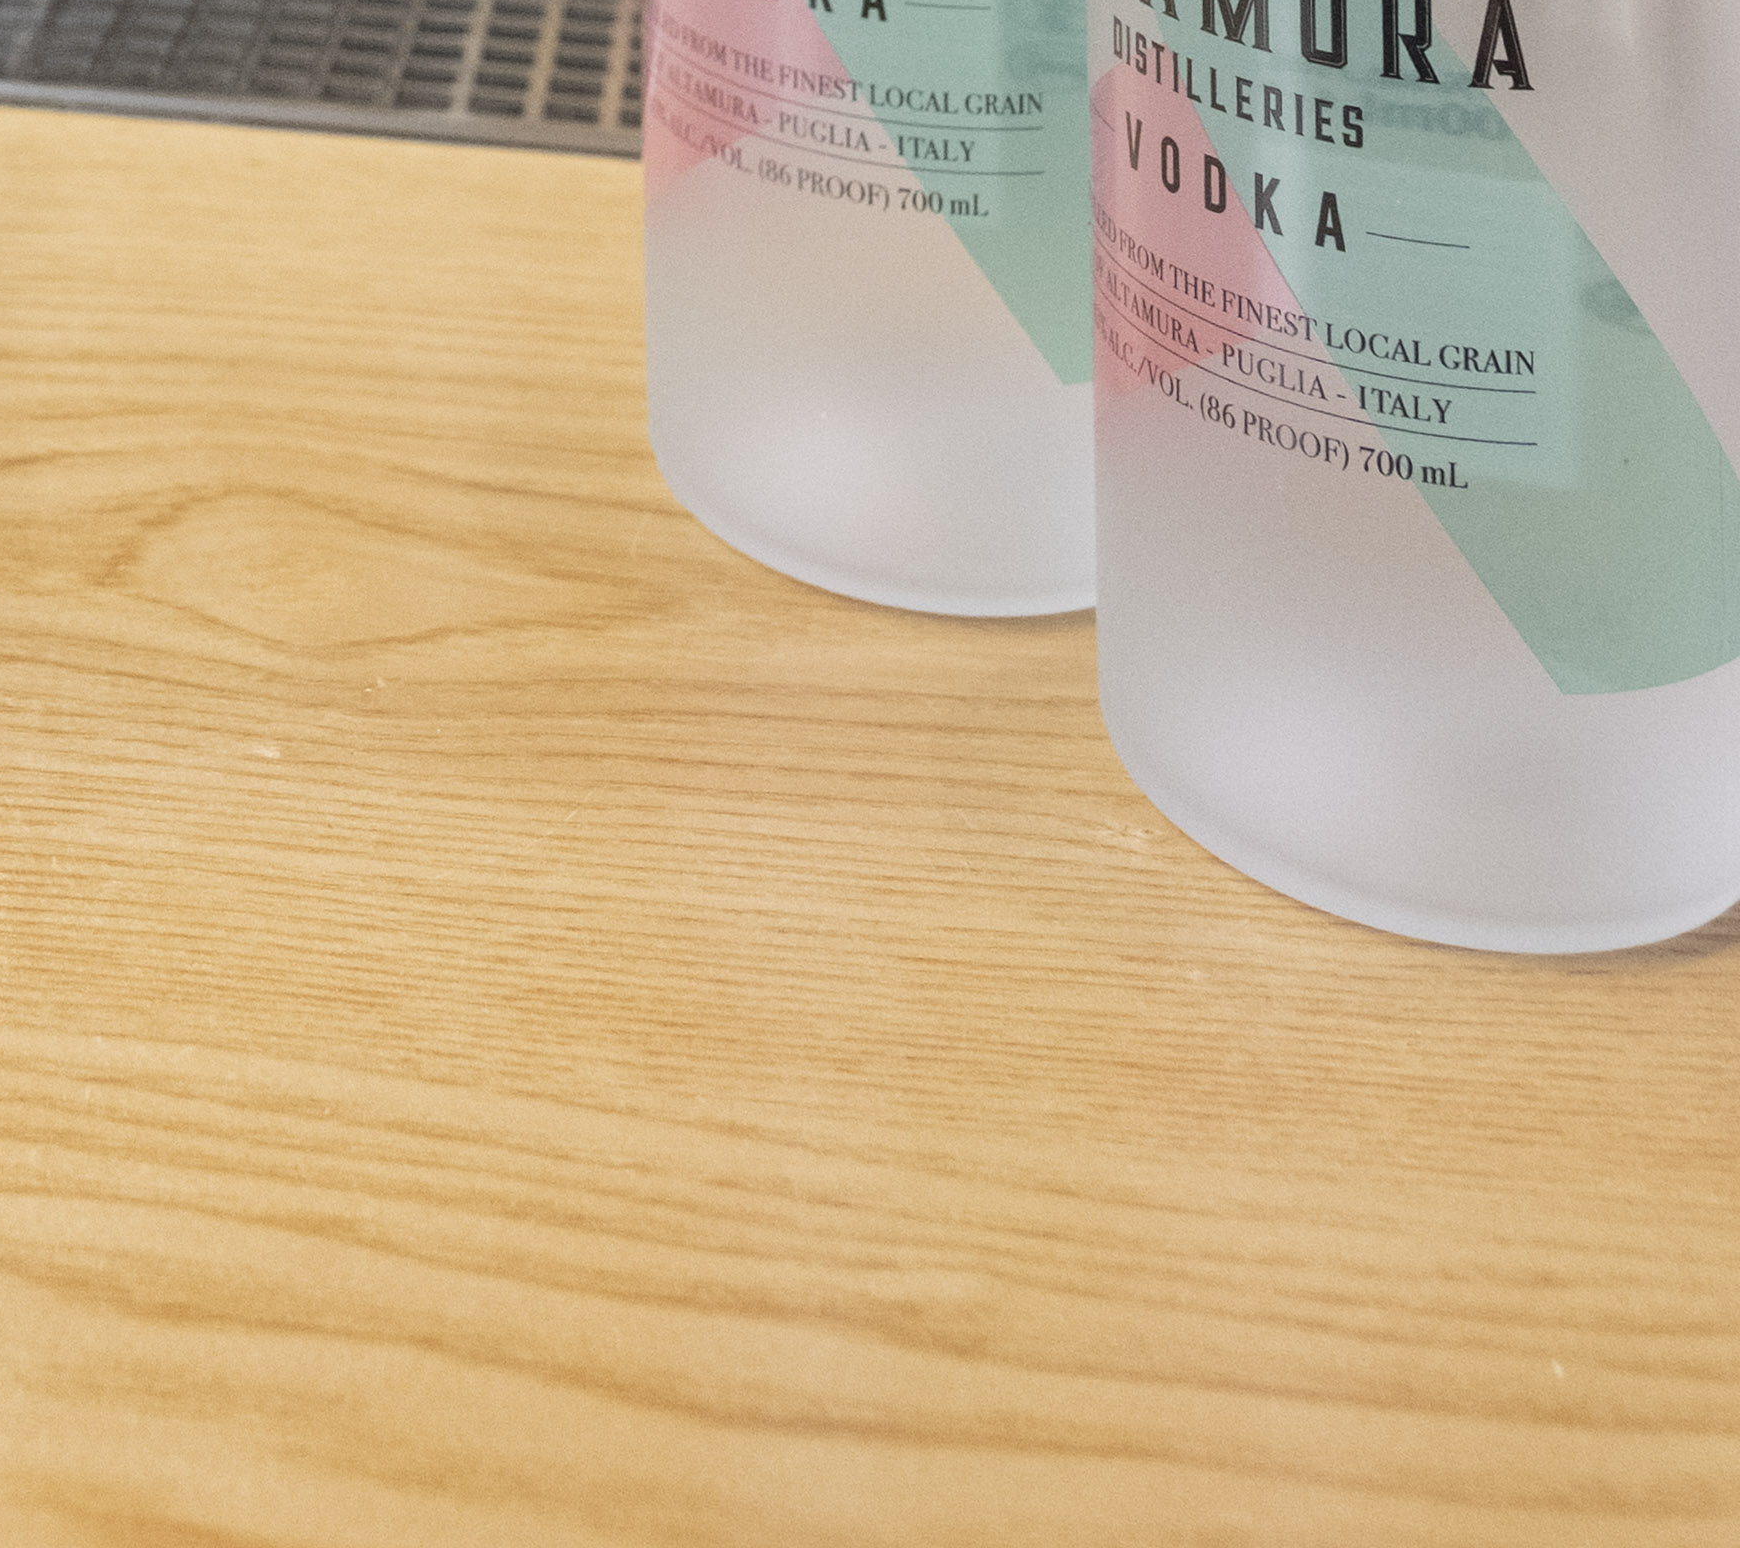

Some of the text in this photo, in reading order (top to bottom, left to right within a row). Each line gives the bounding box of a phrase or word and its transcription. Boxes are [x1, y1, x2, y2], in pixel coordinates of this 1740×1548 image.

[730, 46, 775, 84] THE
[779, 64, 864, 103] FINEST
[868, 83, 960, 115] LOCAL
[964, 92, 1044, 116] GRAIN
[778, 111, 871, 153] PUGLIA
[897, 134, 977, 163] ITALY
[1112, 14, 1365, 151] DISTILLERIES
[796, 164, 891, 211] PROOF)
[897, 187, 944, 215] 700
[950, 194, 990, 218] mL
[1124, 109, 1347, 254] VODKA
[1106, 269, 1200, 355] ALTAMURA
[1221, 341, 1328, 404] PUGLIA
[1358, 384, 1453, 425] ITALY
[1119, 228, 1165, 282] FROM
[1169, 262, 1216, 308] THE
[1221, 287, 1318, 344] FINEST
[1324, 321, 1432, 369] LOCAL
[1439, 343, 1537, 376] GRAIN
[1199, 391, 1237, 431] (86
[1242, 411, 1352, 473] PROOF)
[1358, 445, 1415, 484] 700
[1420, 459, 1470, 493] mL
